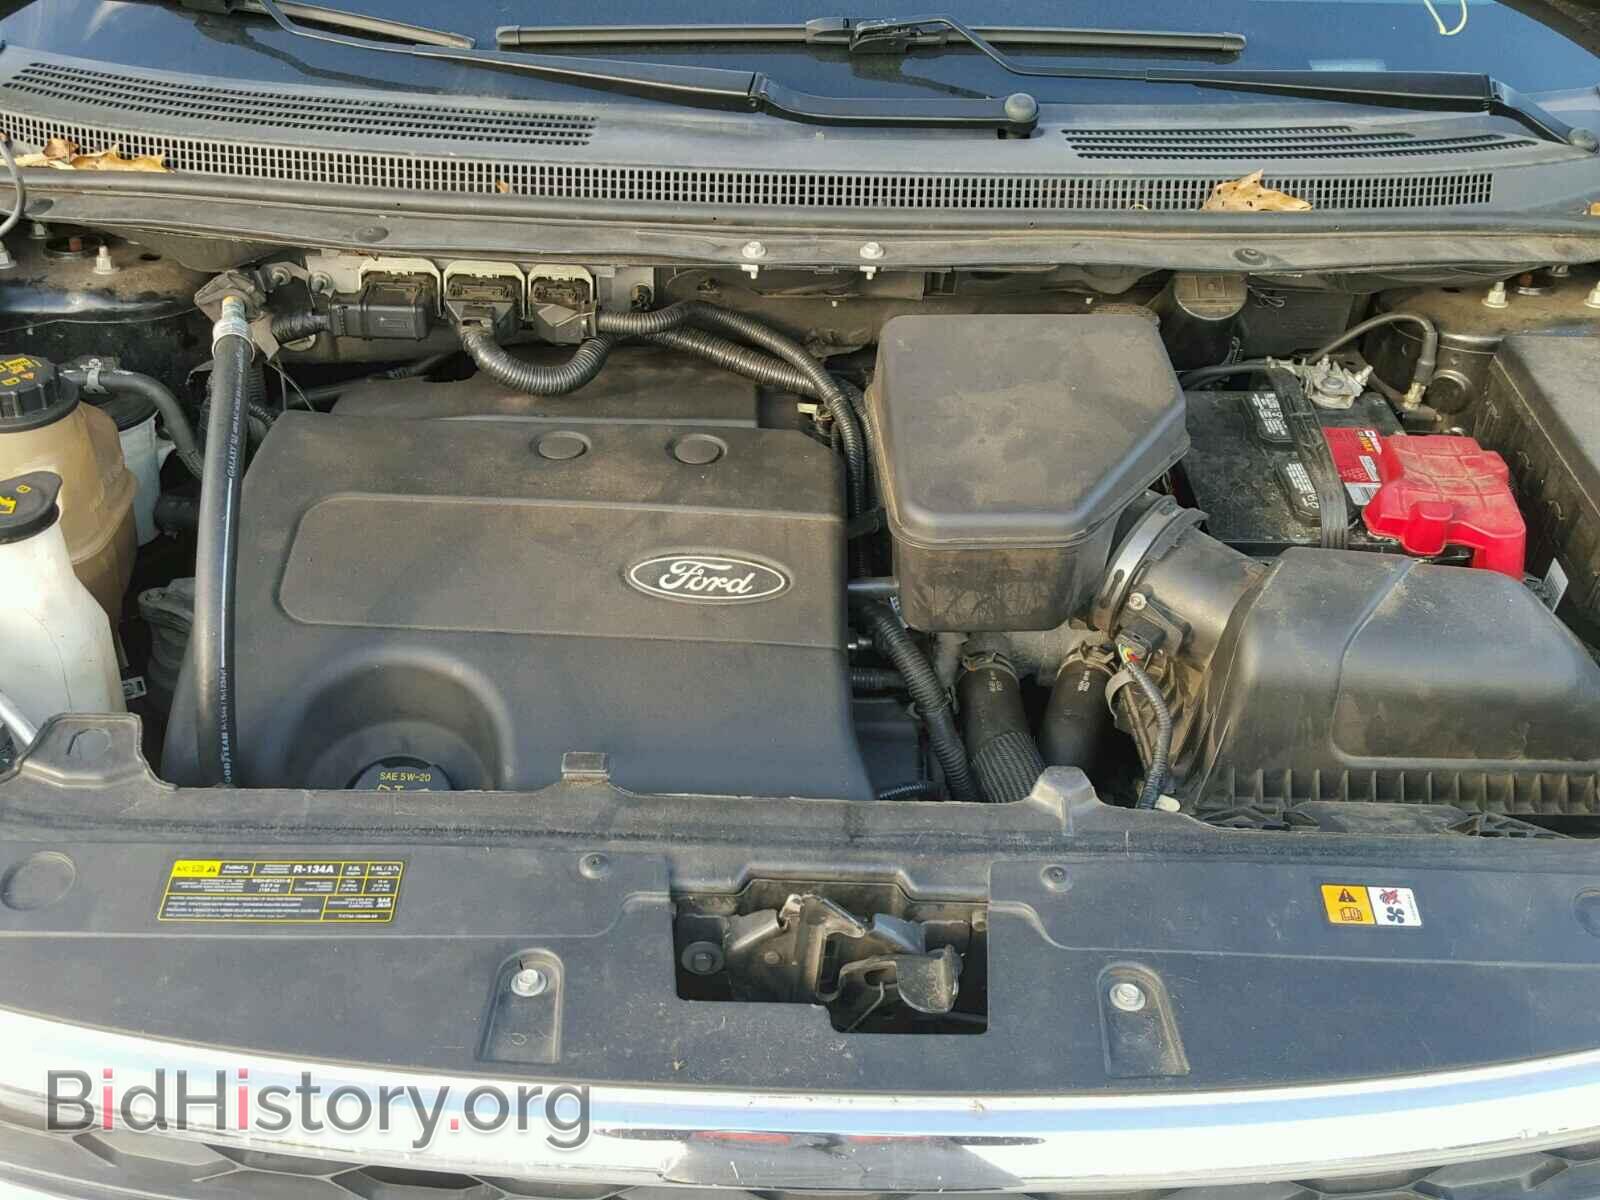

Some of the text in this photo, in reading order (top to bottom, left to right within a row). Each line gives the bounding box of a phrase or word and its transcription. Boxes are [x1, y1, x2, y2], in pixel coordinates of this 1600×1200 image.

[658, 560, 755, 594] Ford
[380, 771, 432, 782] SAE 5W-20
[293, 864, 334, 874] R-134A
